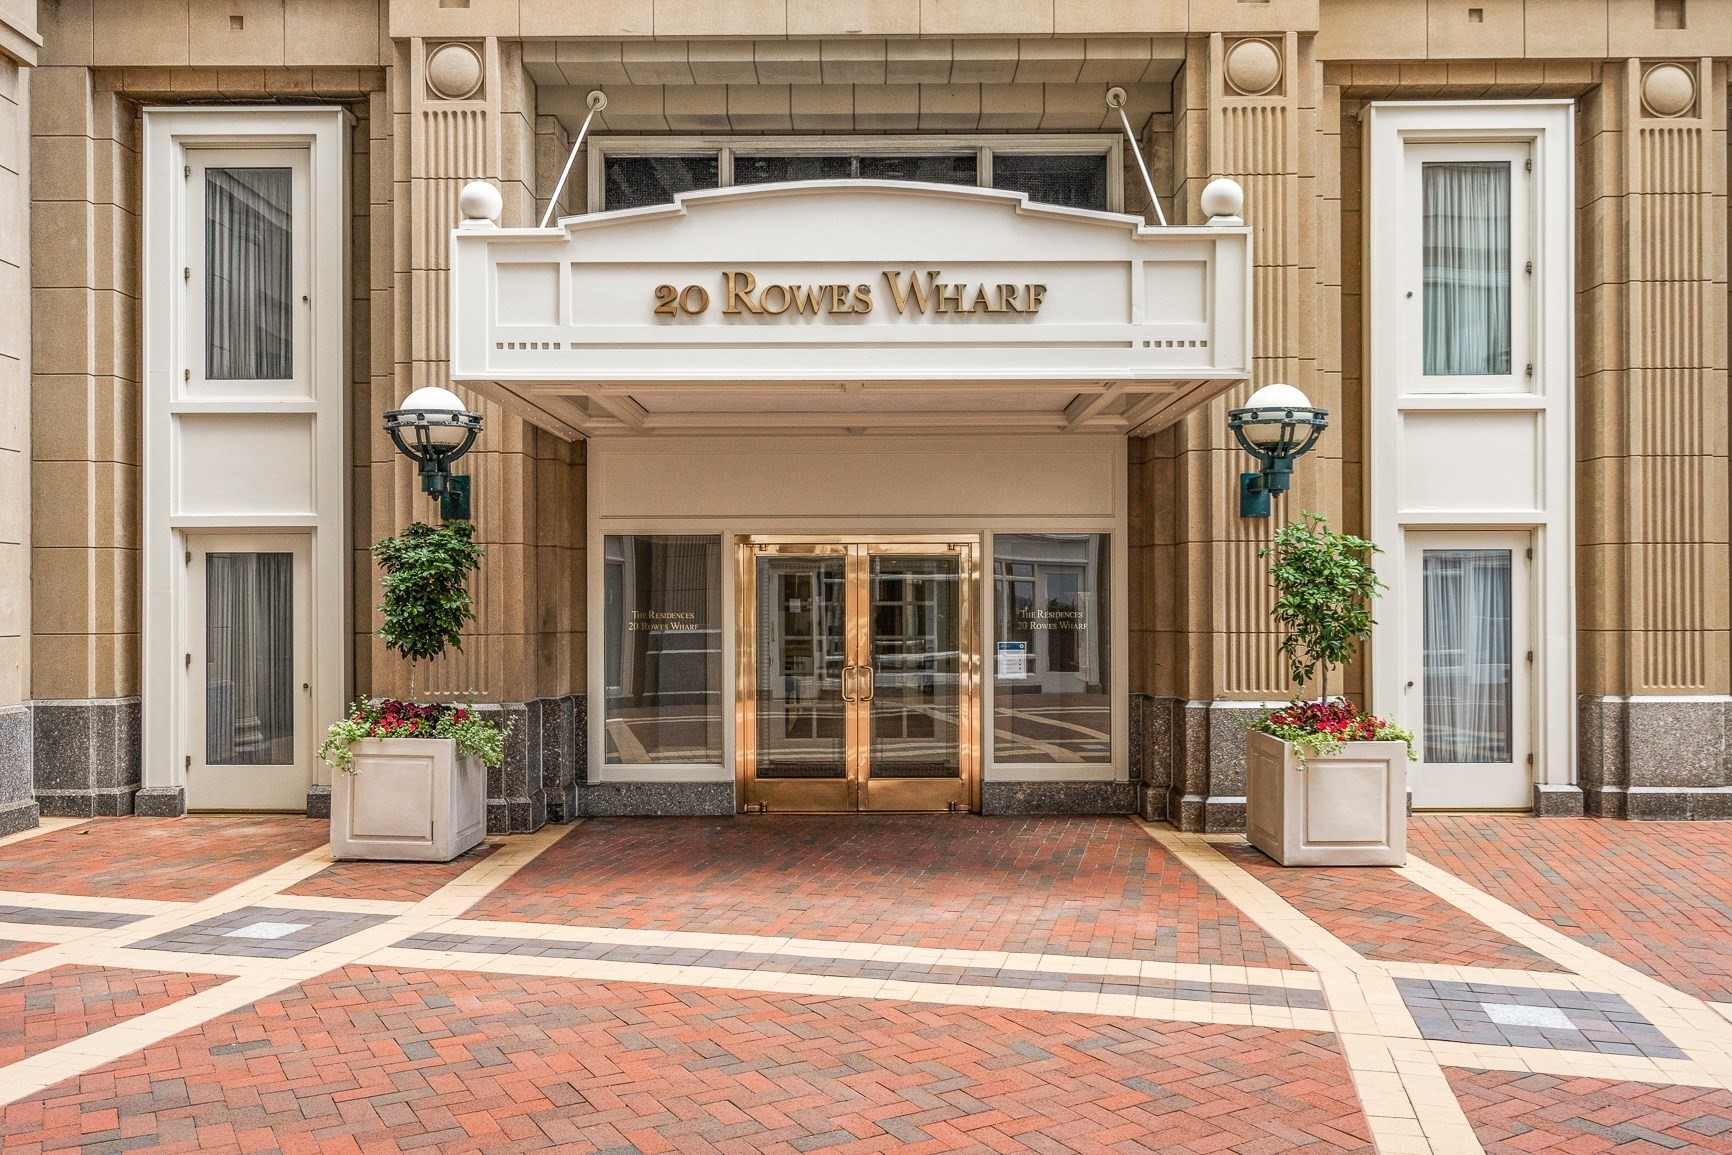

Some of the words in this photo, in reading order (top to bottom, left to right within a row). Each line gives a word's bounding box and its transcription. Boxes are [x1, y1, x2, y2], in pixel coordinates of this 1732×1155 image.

[654, 284, 710, 317] 20
[721, 270, 874, 315] ROWES
[882, 270, 1048, 315] WHARF
[631, 610, 646, 619] THE
[648, 610, 695, 619] RESIDENCES
[1021, 609, 1036, 619] THE
[1037, 609, 1083, 619] RESIDENCES
[628, 622, 639, 631] 20
[641, 622, 669, 631] ROWES
[670, 622, 699, 631] WHARF
[1017, 621, 1028, 630] 20
[1030, 621, 1058, 630] ROWES
[1059, 621, 1088, 630] WHARF
